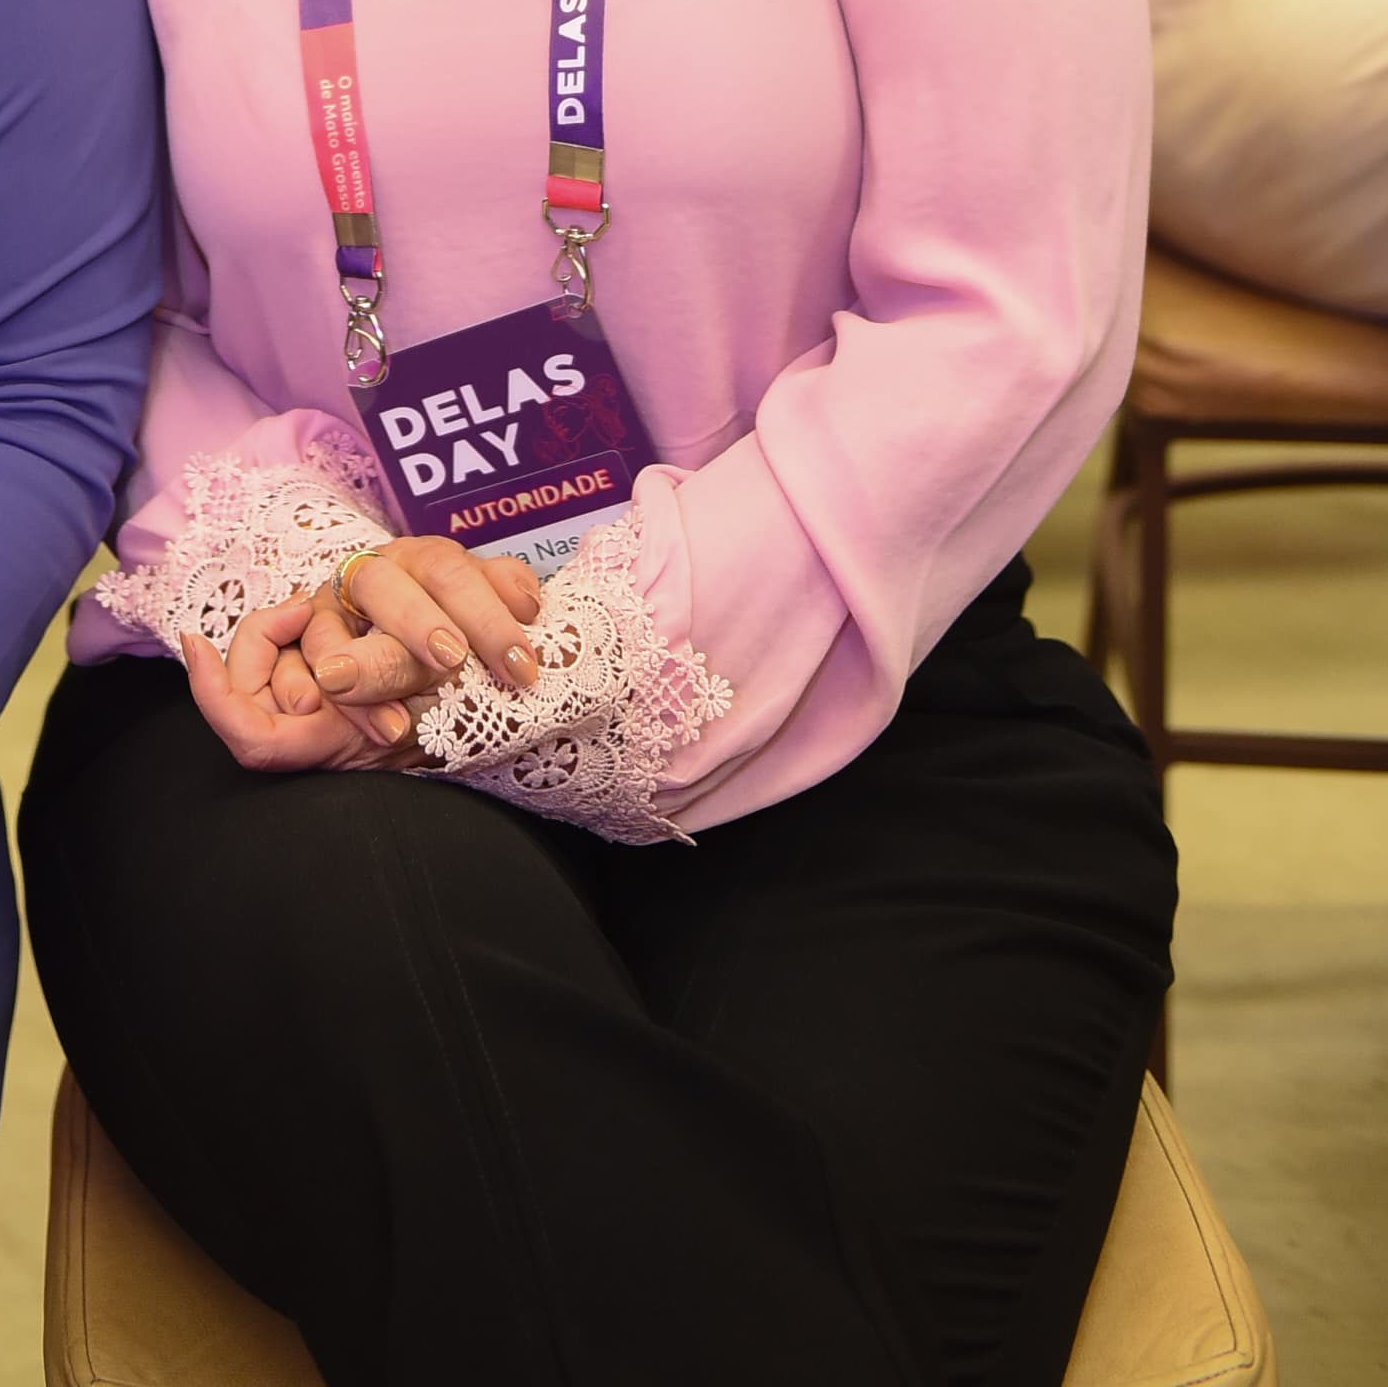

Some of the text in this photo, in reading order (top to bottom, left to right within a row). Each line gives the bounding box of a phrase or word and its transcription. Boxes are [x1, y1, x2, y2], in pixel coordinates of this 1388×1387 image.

[319, 78, 350, 212] de Mato Grosso
[338, 75, 365, 209] O maior evento
[379, 354, 586, 450] DELAS
[399, 422, 520, 497] DAY
[449, 469, 615, 533] AUTORIDADE
